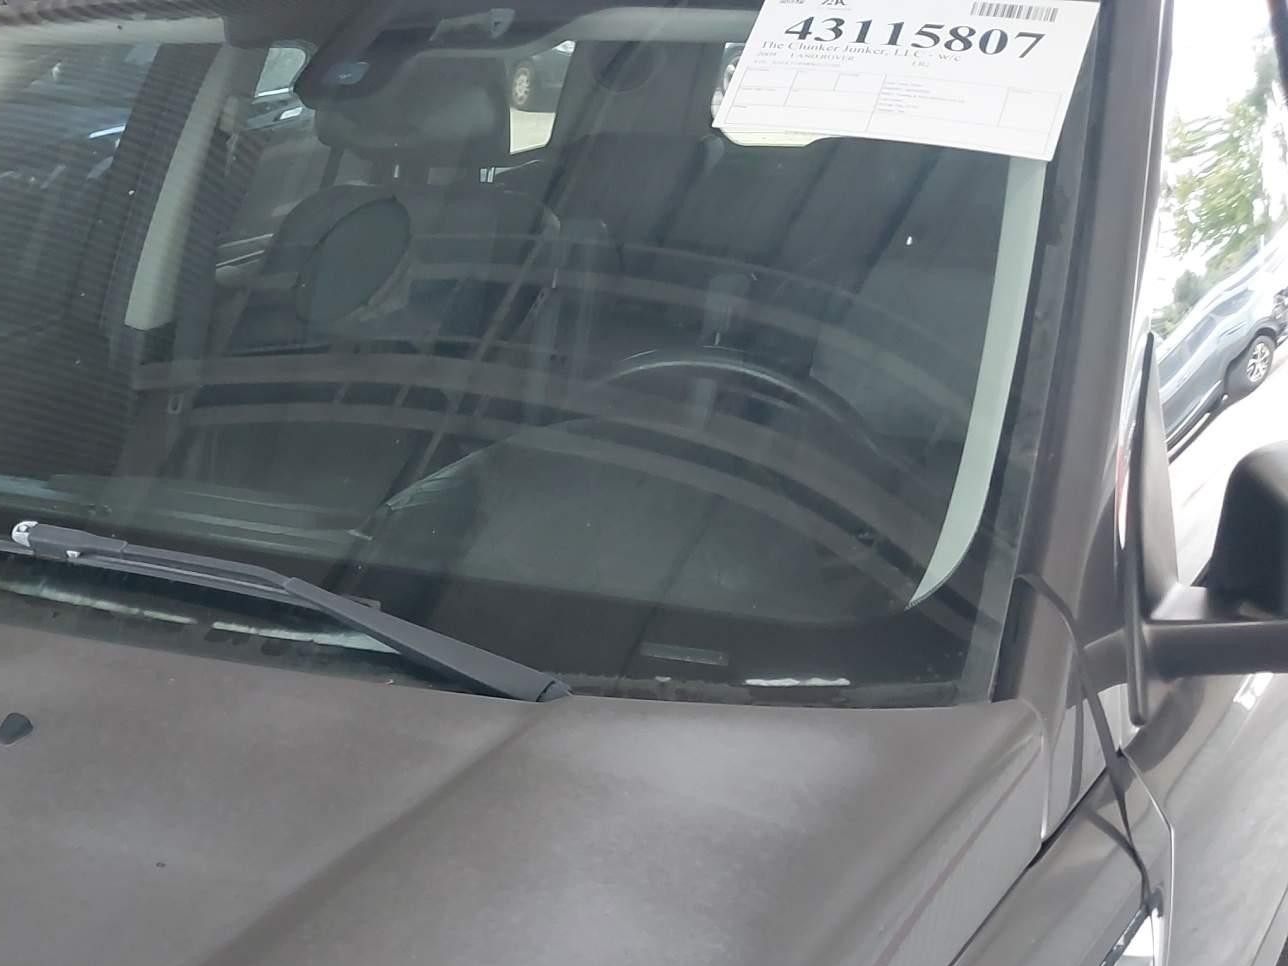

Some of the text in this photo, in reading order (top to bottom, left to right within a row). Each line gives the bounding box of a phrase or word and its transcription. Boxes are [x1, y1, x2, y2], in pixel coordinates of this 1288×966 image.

[762, 40, 785, 50] The
[788, 42, 840, 53] Clunker
[784, 16, 1046, 59] 43115807
